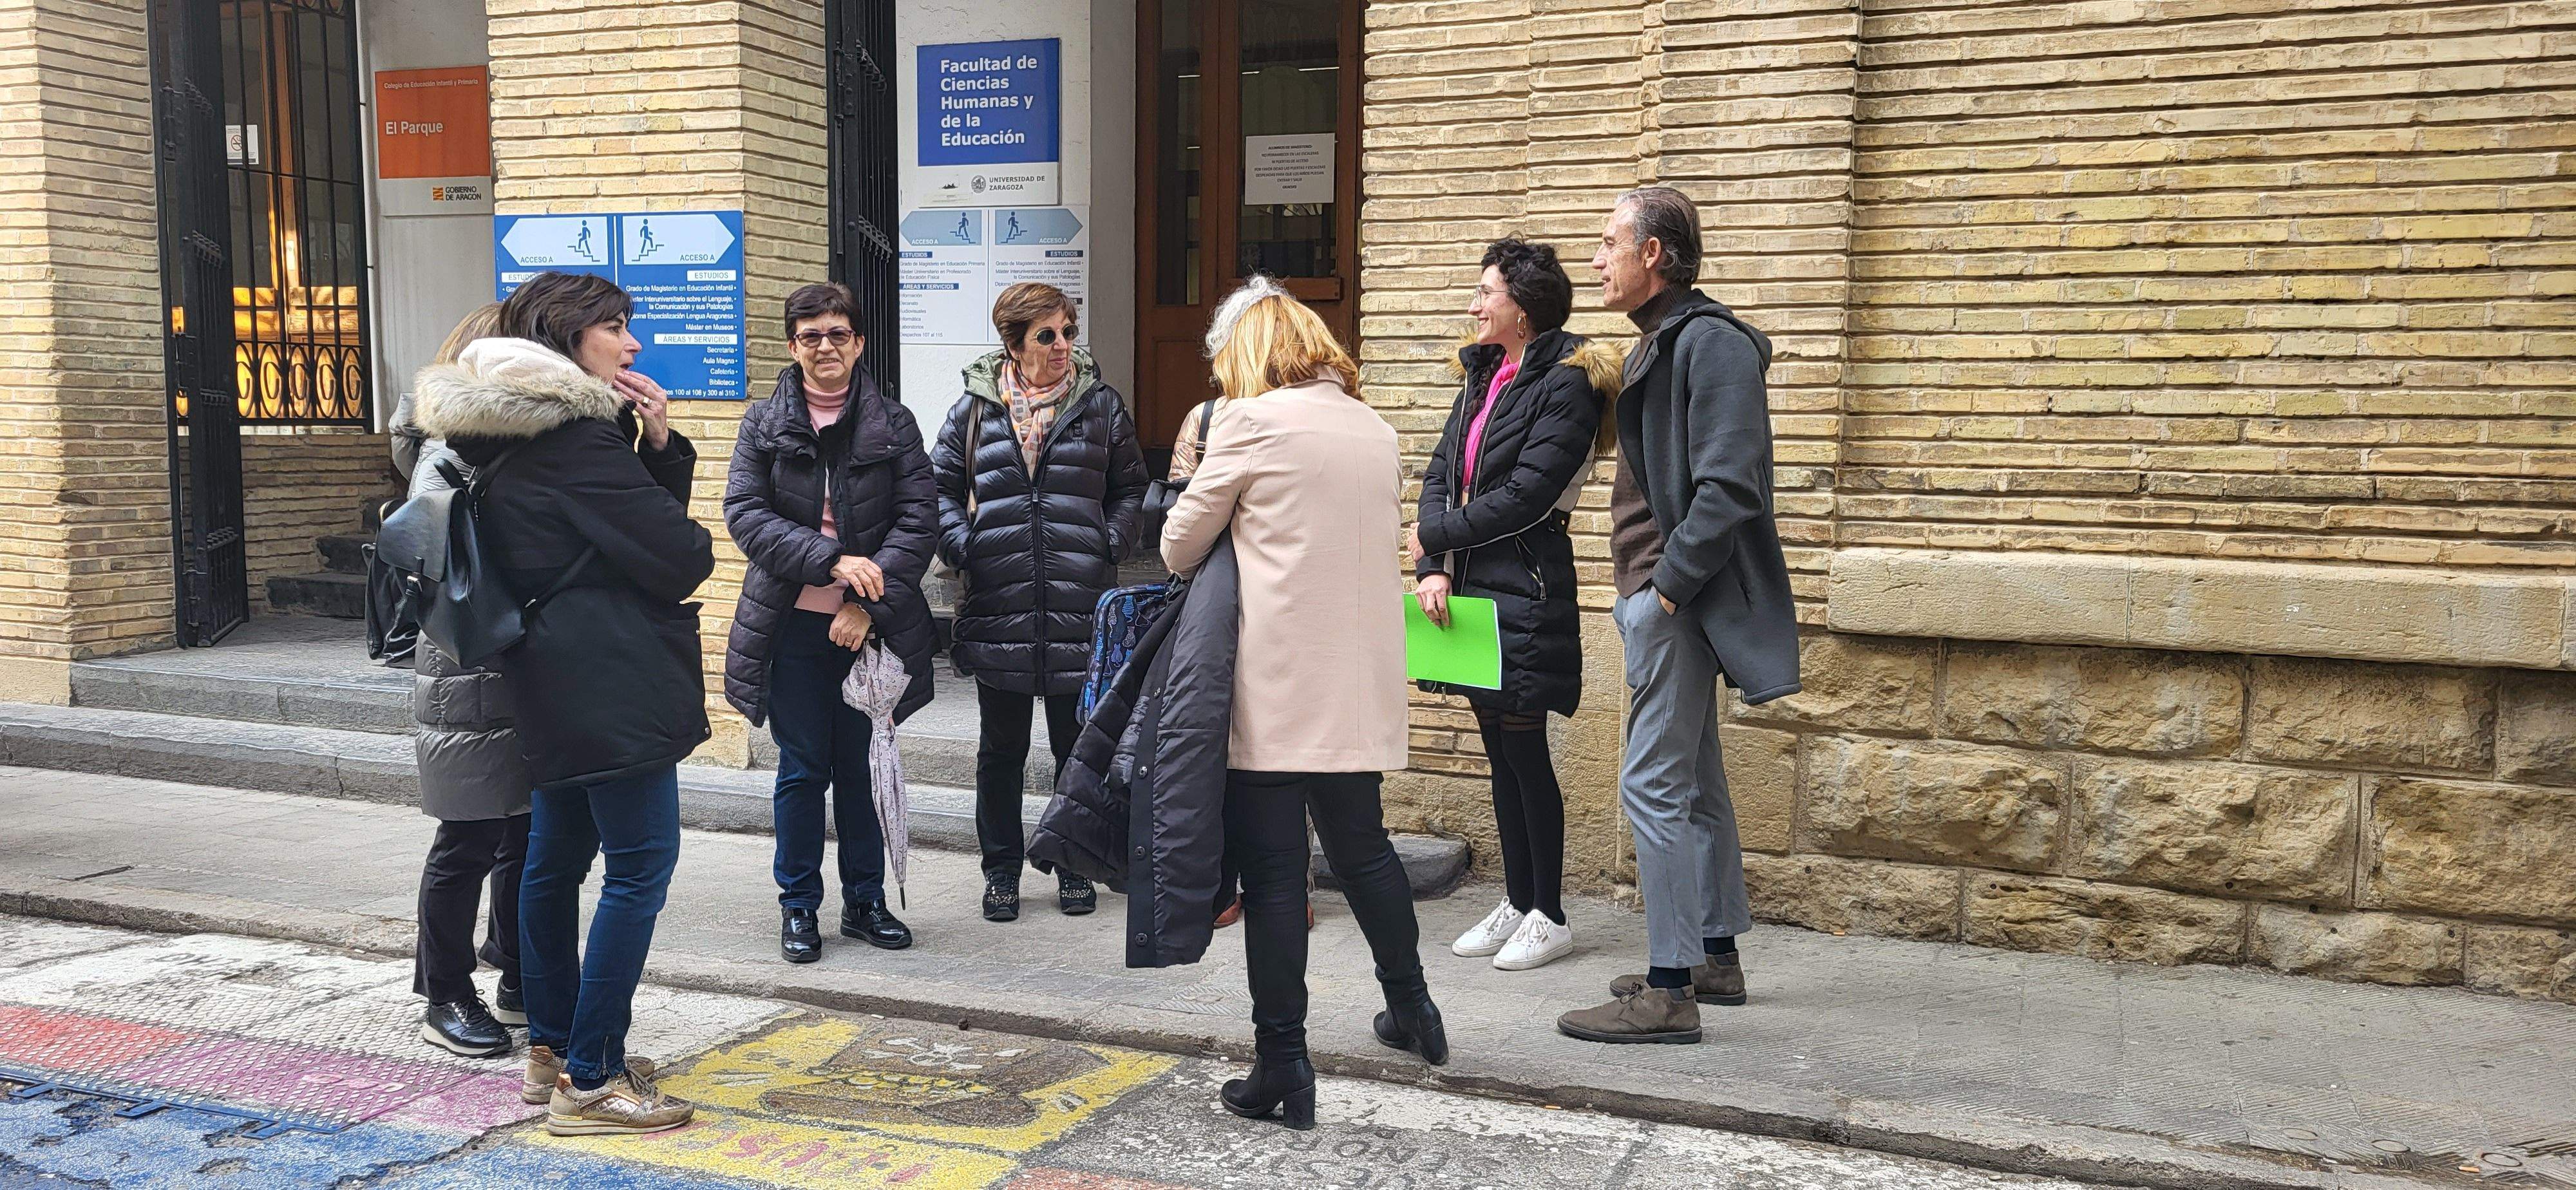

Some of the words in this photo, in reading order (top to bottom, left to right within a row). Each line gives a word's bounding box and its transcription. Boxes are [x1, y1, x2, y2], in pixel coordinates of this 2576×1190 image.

[941, 56, 1011, 73] Facultad
[1017, 55, 1037, 69] de
[941, 76, 1009, 91] Ciencias
[941, 96, 1018, 110] Humanas
[1024, 96, 1033, 109] y
[386, 122, 397, 134] El
[401, 121, 443, 136] Parque
[941, 115, 961, 128] de
[967, 114, 980, 127] la
[942, 129, 1025, 146] Educación
